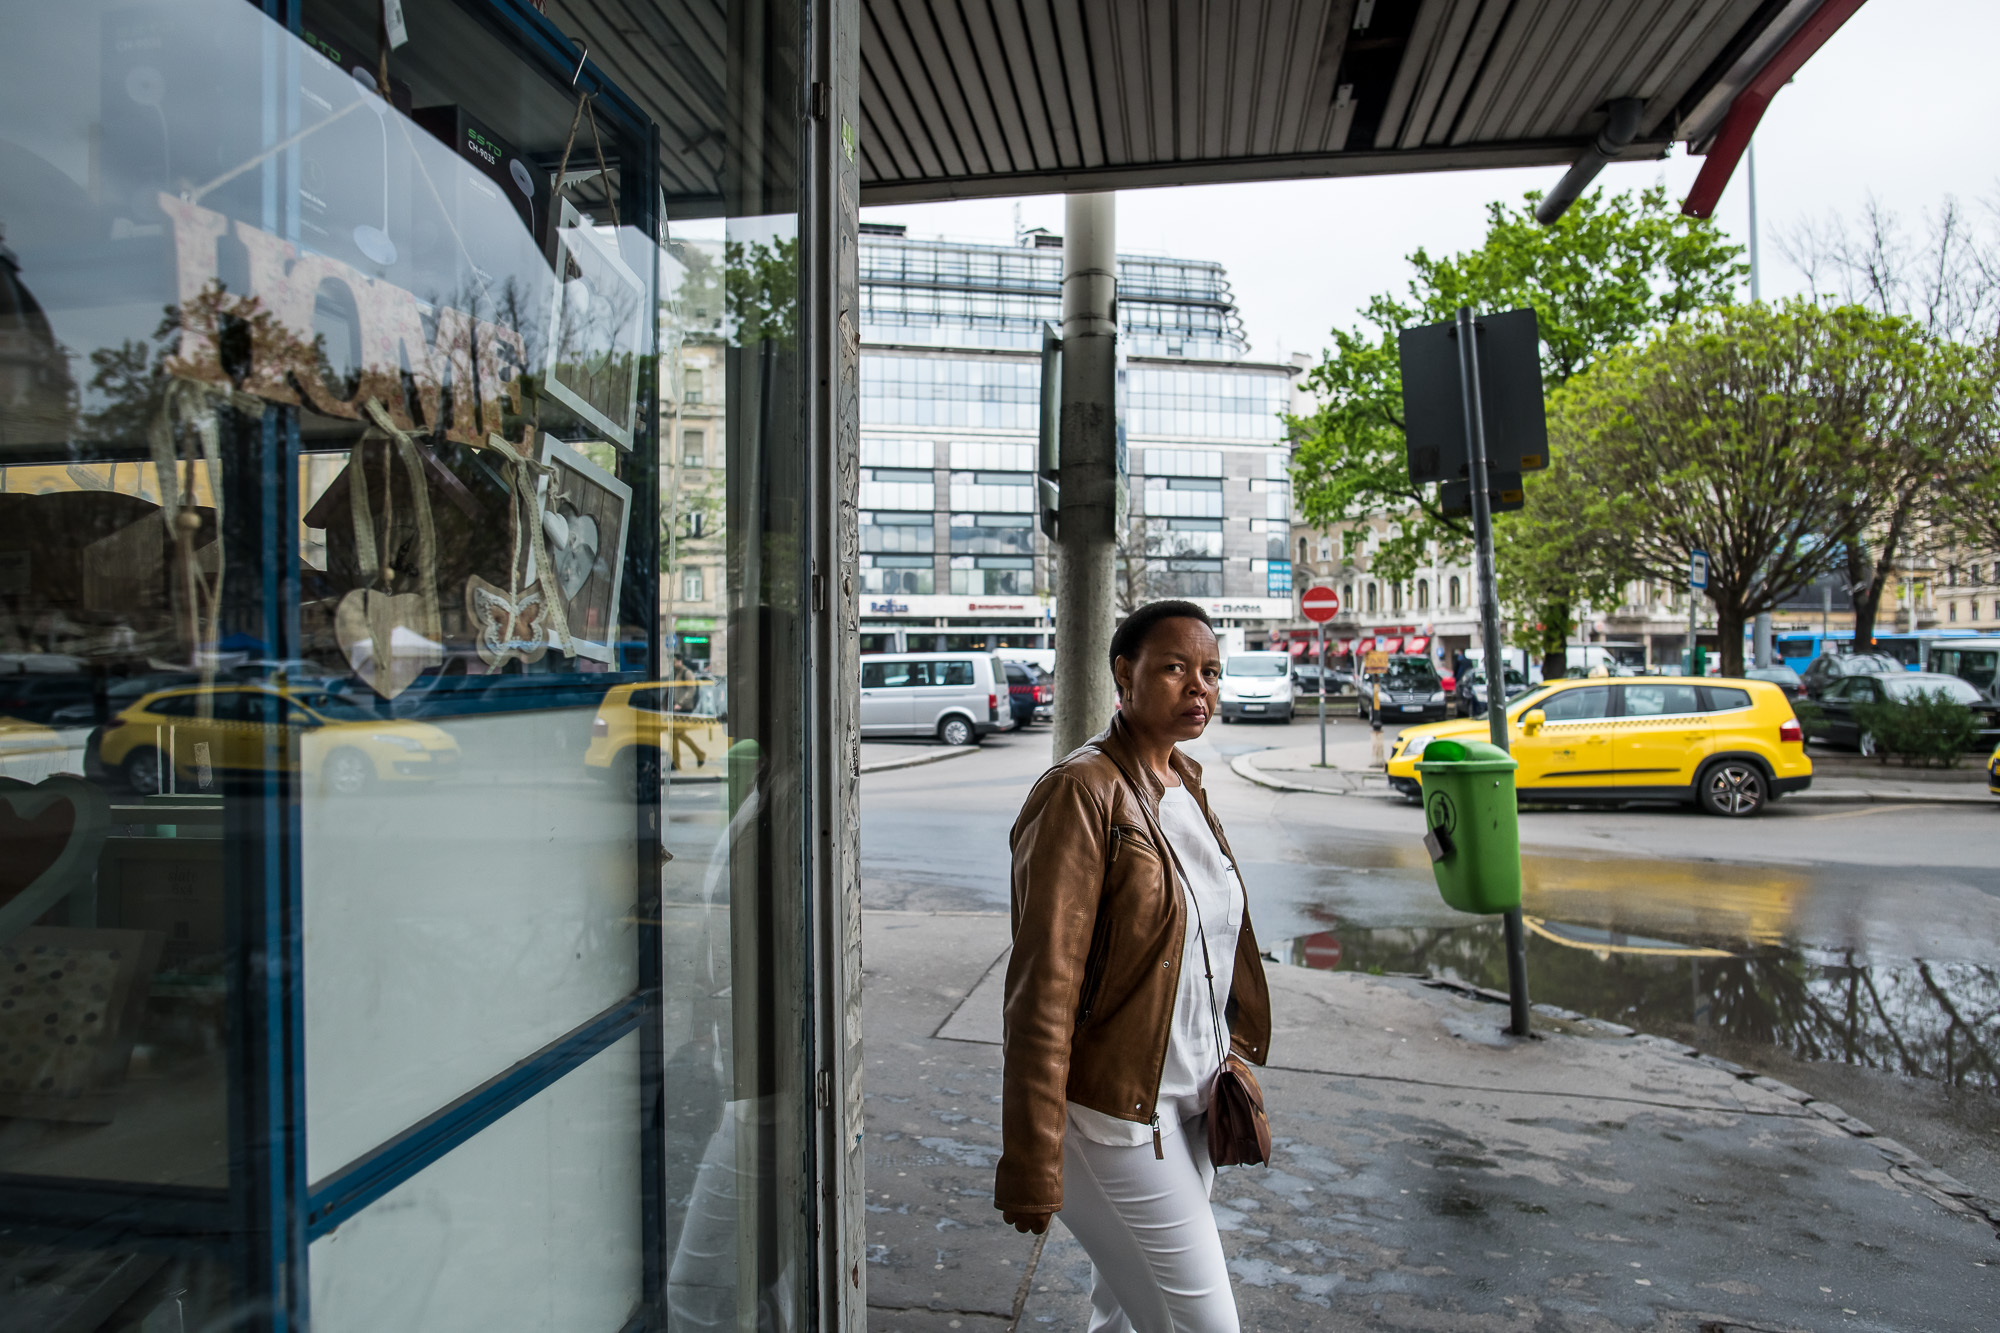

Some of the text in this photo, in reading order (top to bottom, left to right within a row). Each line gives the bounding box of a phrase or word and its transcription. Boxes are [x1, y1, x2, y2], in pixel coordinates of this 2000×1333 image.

[467, 128, 502, 158] SSTD
[467, 140, 496, 166] CH-9035
[158, 191, 534, 453] HOME
